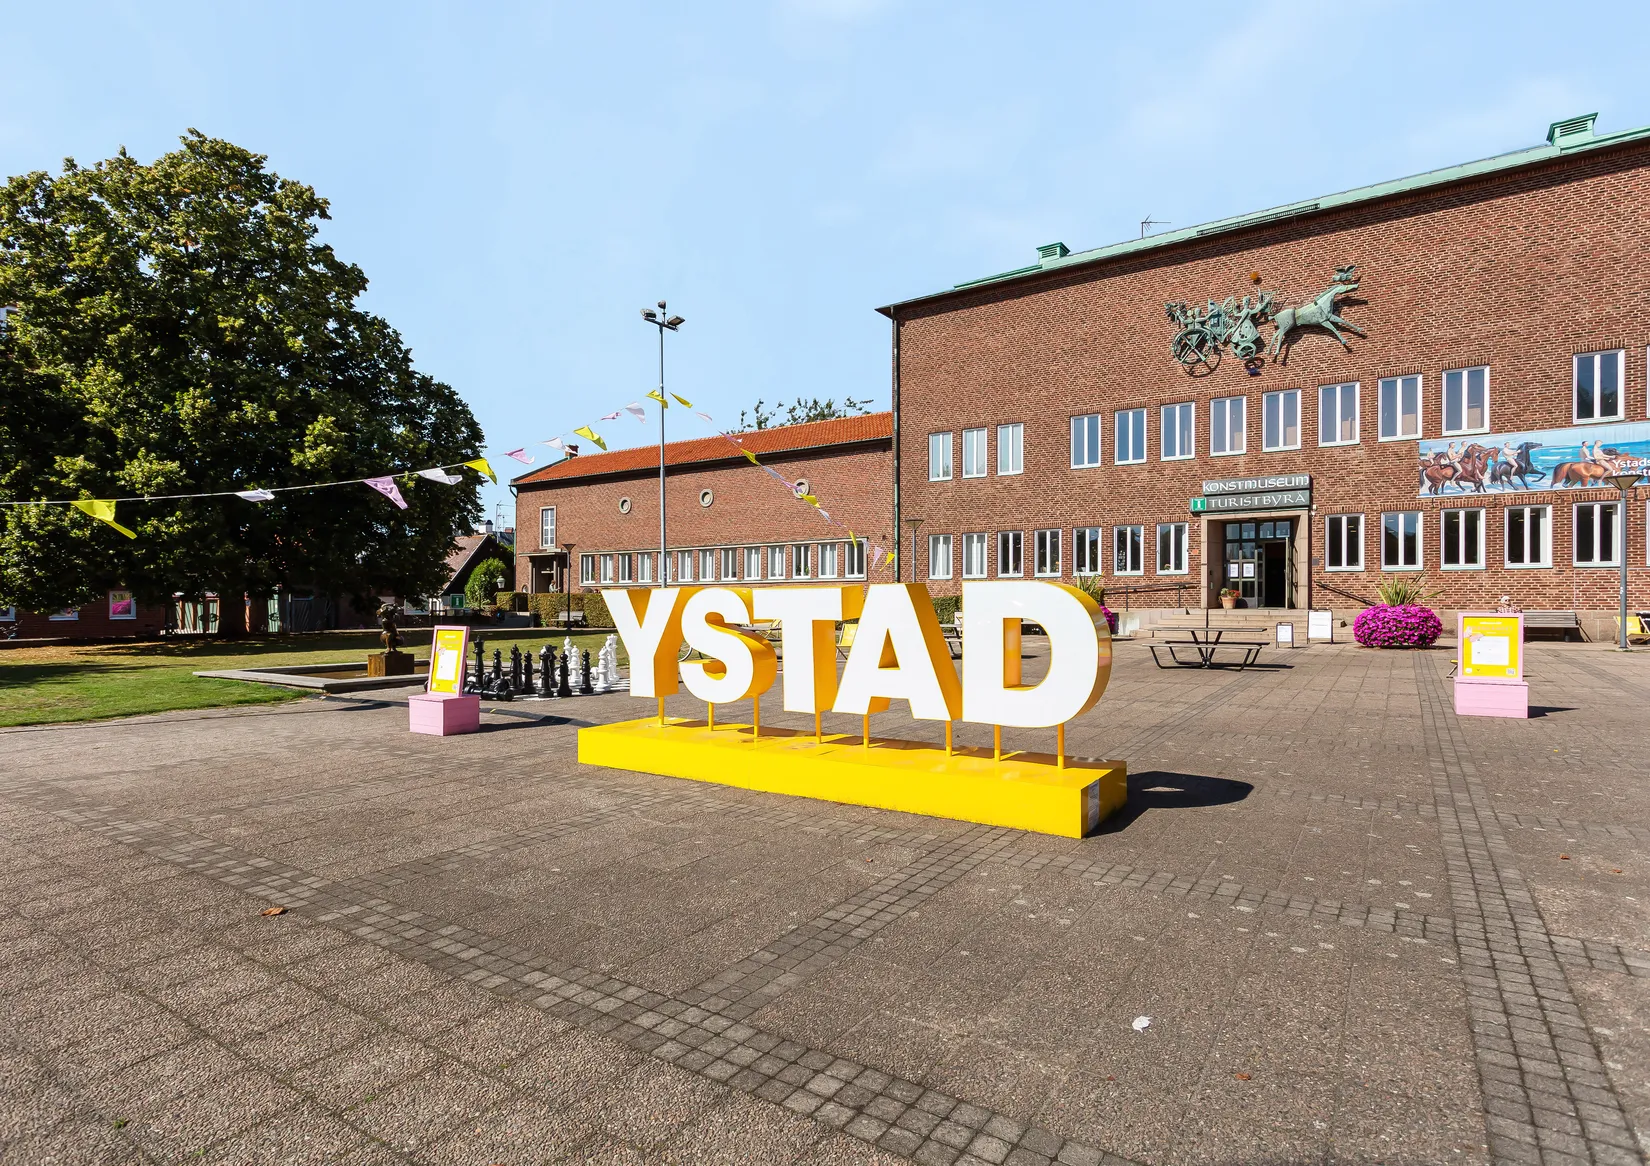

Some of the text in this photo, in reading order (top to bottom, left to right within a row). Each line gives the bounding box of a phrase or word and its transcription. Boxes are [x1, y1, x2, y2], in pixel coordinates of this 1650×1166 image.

[1612, 458, 1650, 468] Ystads
[1612, 469, 1650, 477] konst
[1203, 476, 1309, 492] KONSTMUSEUM
[1209, 491, 1306, 507] TURISTBYRÅ
[601, 580, 1112, 728] YSTAD
